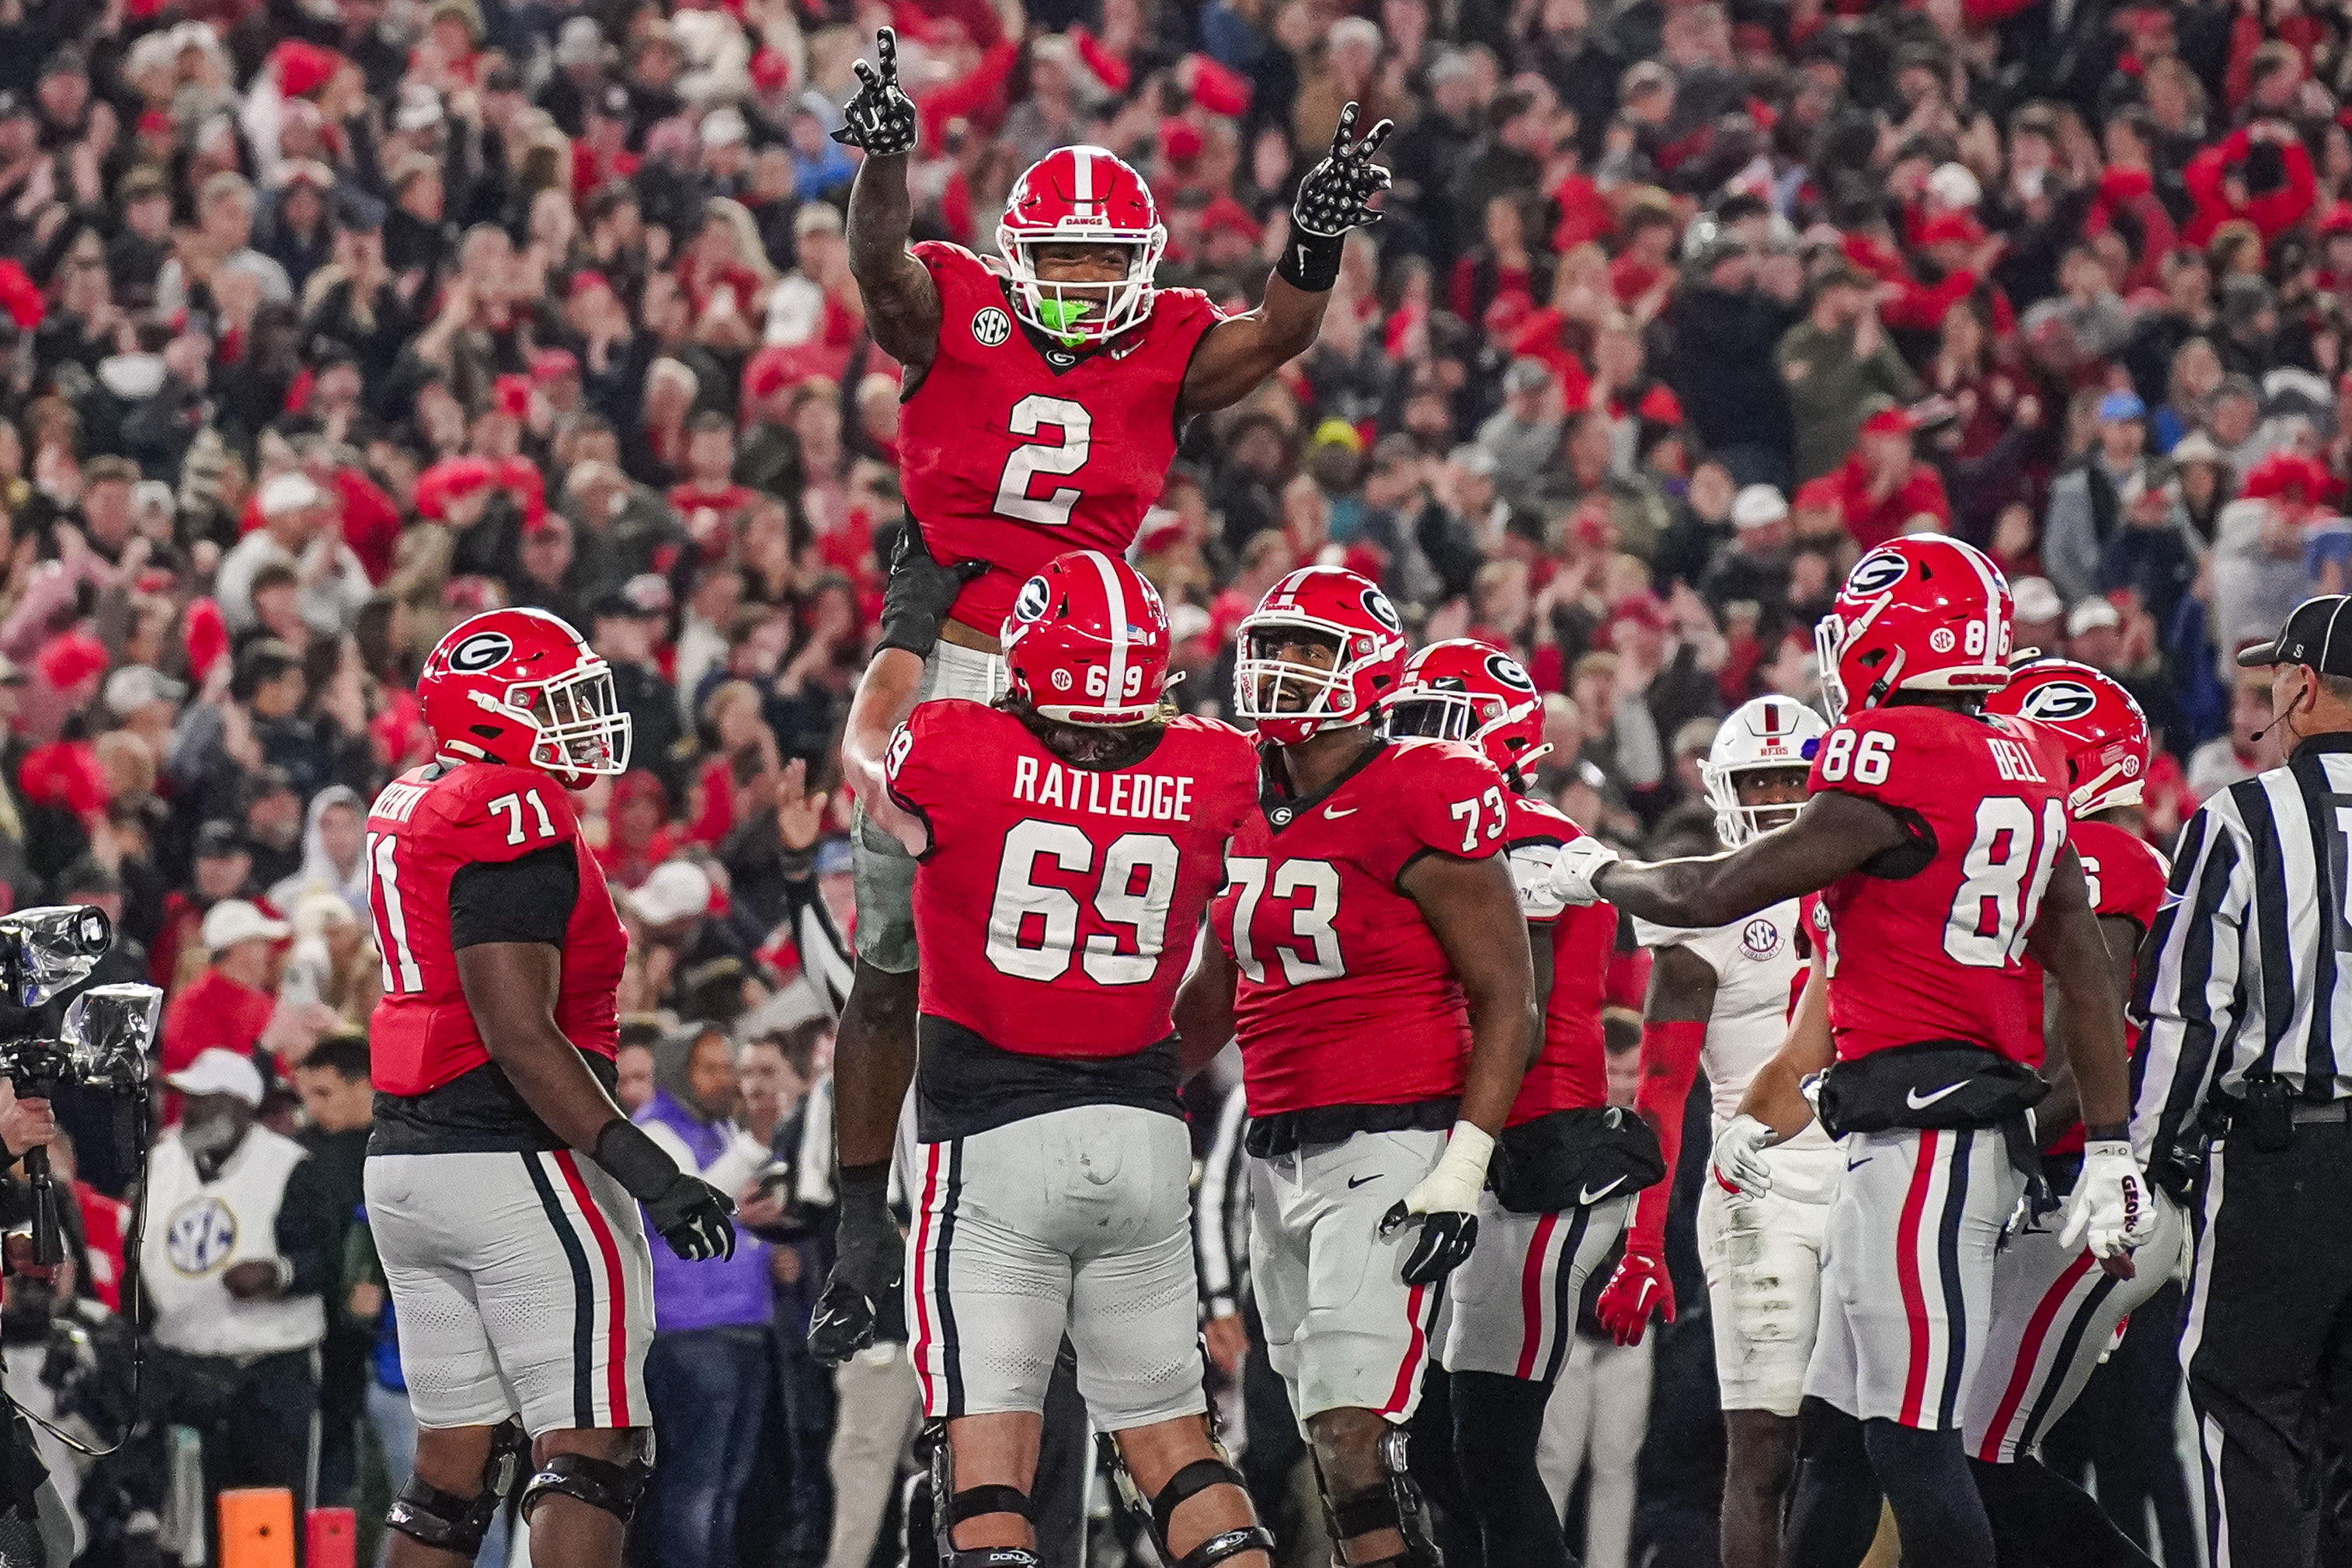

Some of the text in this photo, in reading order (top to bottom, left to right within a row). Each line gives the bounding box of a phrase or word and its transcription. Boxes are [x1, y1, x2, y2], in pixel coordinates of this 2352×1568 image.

[975, 308, 1010, 344] SEC
[1051, 351, 1075, 363] G
[992, 392, 1094, 525] 2
[1853, 557, 1907, 590] G
[457, 635, 513, 667] G
[1932, 630, 1953, 651] SEC
[1964, 619, 2011, 656] 86
[1052, 670, 1070, 689] SEC
[1084, 665, 1143, 698] 69
[1821, 728, 1897, 786] 86
[1985, 737, 2048, 784] BELL
[1012, 755, 1195, 822] RATLEDGE
[487, 787, 557, 847] 71
[1271, 808, 1292, 824] G
[1449, 784, 1508, 854] 73
[984, 816, 1181, 986] 69
[1217, 856, 1348, 987] 73
[1745, 920, 1777, 951] SEC
